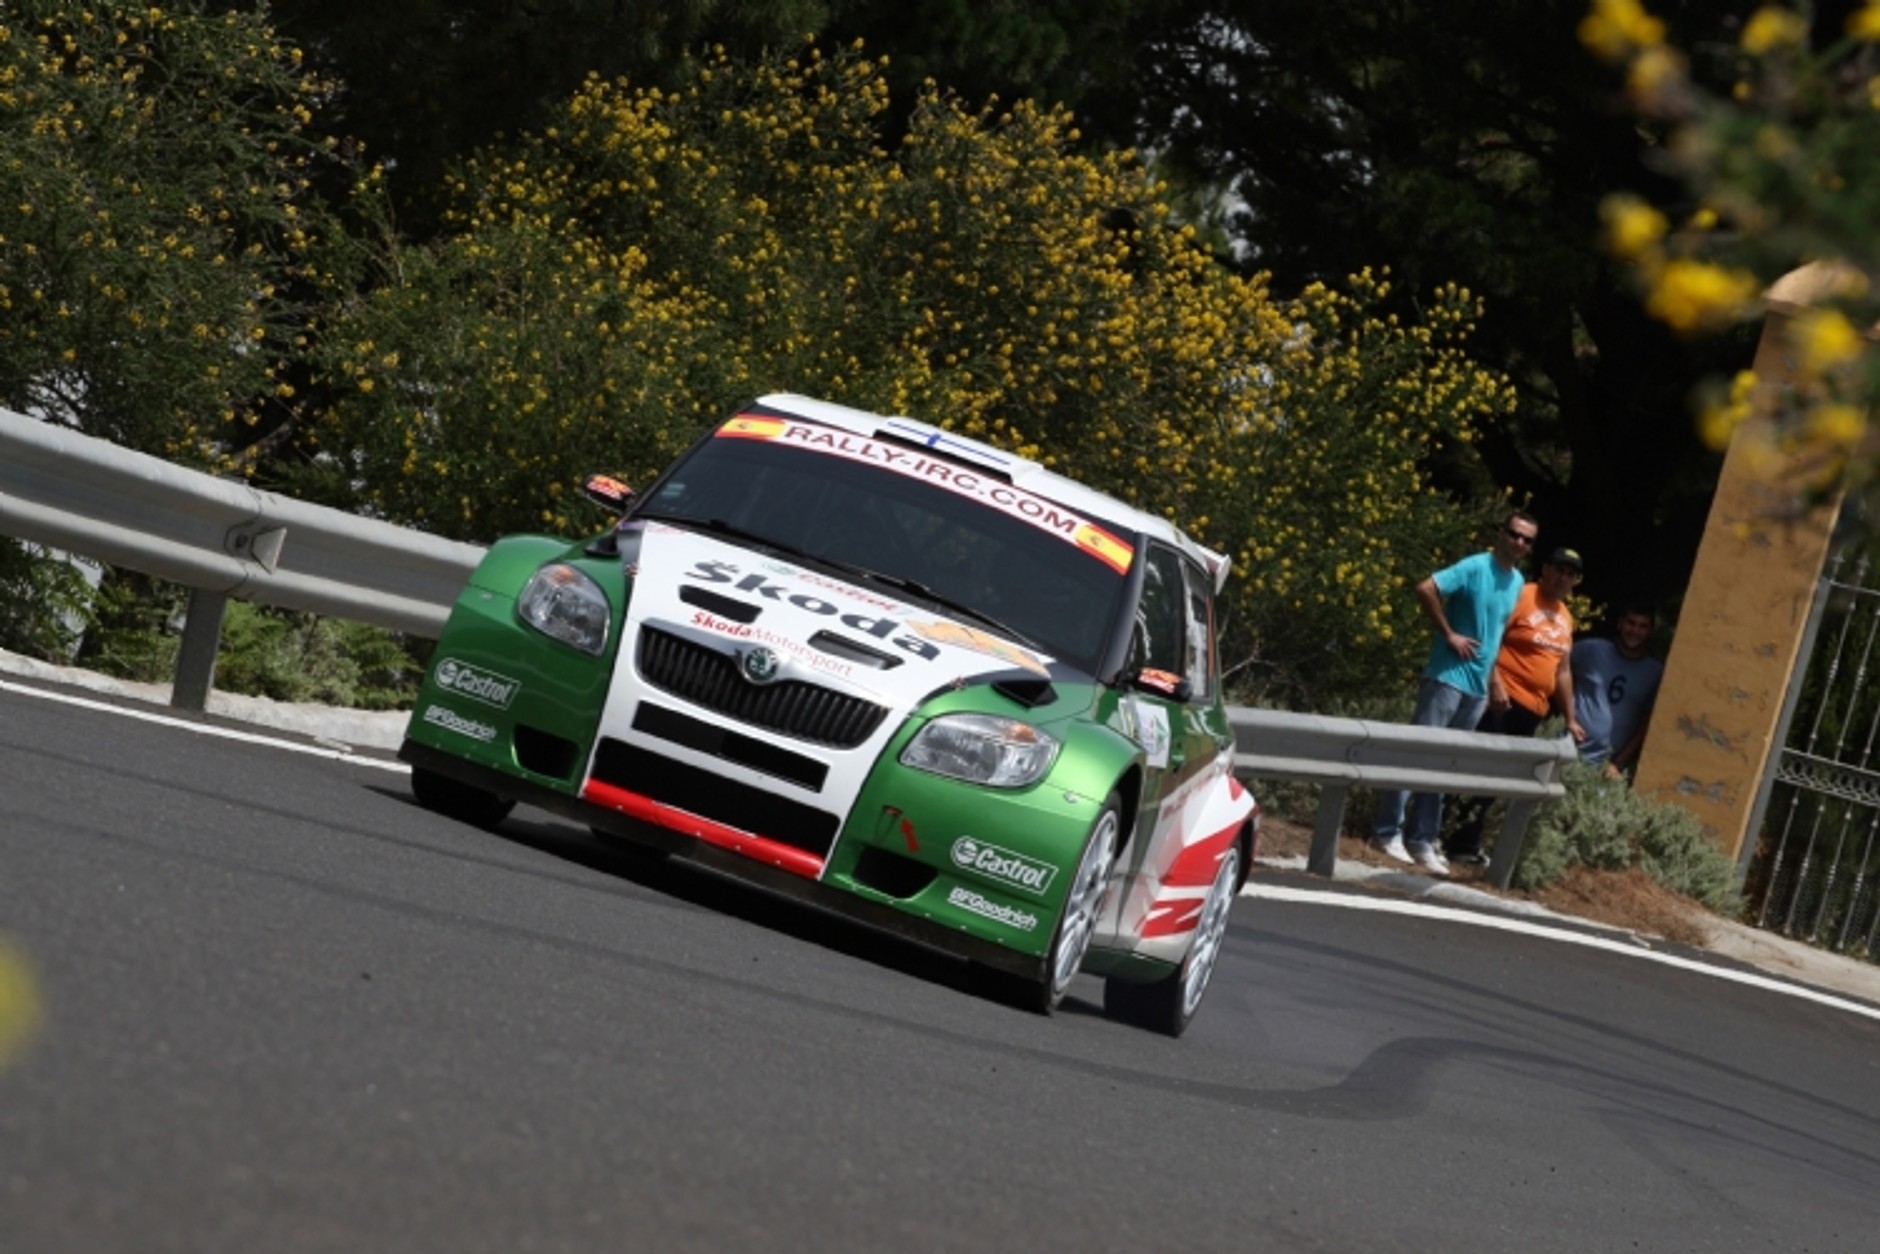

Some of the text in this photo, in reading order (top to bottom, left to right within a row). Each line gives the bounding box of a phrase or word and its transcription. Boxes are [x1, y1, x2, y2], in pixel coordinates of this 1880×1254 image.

[784, 426, 1077, 534] RALLY-IRC.COM
[455, 669, 513, 703] Castrol
[1607, 674, 1627, 704] 6
[425, 704, 497, 742] BFGoodrich
[975, 848, 1048, 888] Castrol
[948, 886, 1037, 931] BFGoodrich
